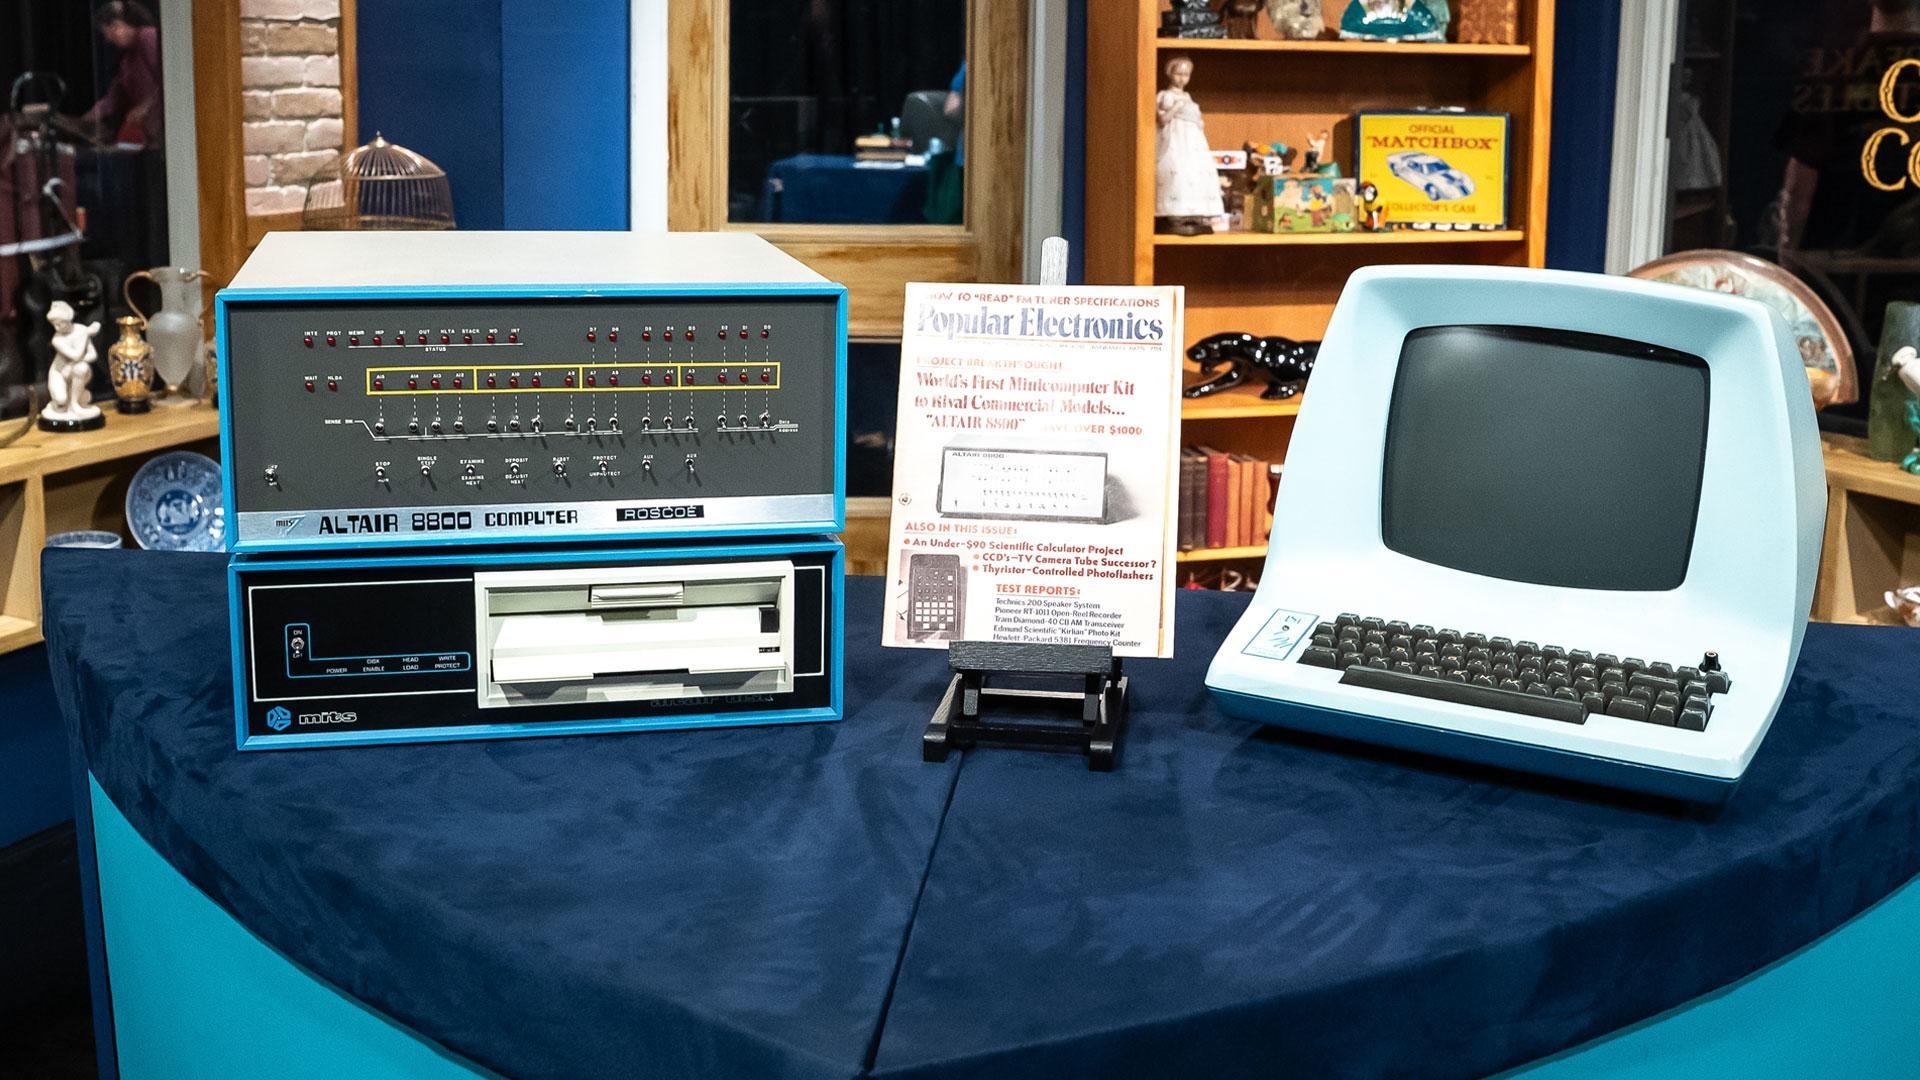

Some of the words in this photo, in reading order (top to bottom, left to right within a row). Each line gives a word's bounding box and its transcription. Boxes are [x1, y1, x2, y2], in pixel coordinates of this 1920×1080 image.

[1408, 124, 1455, 134] OFFICIAL
[1451, 203, 1476, 213] CASE
[974, 293, 1014, 303] "READ"
[1073, 297, 1161, 308] SPECIFICATIONS
[917, 303, 1014, 340] Popular
[1019, 306, 1163, 341] Electronics
[916, 356, 963, 367] POJECT
[916, 372, 969, 389] World's
[972, 374, 1005, 391] First
[1009, 377, 1110, 397] Minicomputer
[1113, 380, 1135, 396] Kit
[915, 396, 928, 408] to
[971, 395, 1055, 413] Commercial
[926, 414, 982, 429] "ALTAIR
[1109, 424, 1143, 436] $1000
[623, 507, 698, 520] ROSCOE
[318, 513, 399, 535] ALTAIR
[411, 511, 472, 532] 8800
[484, 509, 578, 527] COMPUTER
[905, 522, 936, 532] ALSO
[939, 523, 951, 533] IN
[954, 524, 978, 534] THIS
[912, 538, 927, 547] An
[930, 538, 987, 550] Under-$90
[988, 541, 1034, 552] Scientific
[1036, 543, 1086, 554] Calculator
[1088, 545, 1124, 557] Project
[1035, 554, 1072, 565] Camera
[1074, 556, 1099, 567] Tube
[982, 564, 1085, 578] Thyristor-Controlled
[1087, 568, 1154, 581] Photoflashers
[996, 583, 1022, 593] TEST
[1024, 585, 1081, 596] REPORTS:
[995, 597, 1026, 606] Technics
[1027, 599, 1043, 607] 200
[1043, 600, 1072, 608] Speaker
[1073, 601, 1101, 609] System
[994, 606, 1022, 614] Pioneer
[1089, 611, 1122, 619] Recorder
[993, 624, 1023, 633] Edmund
[1024, 625, 1057, 634] Scientific
[1088, 629, 1110, 637] Photo
[1084, 619, 1125, 629] Transceiver
[1073, 636, 1112, 646] Frequency
[1112, 638, 1141, 648] Counter
[434, 662, 461, 670] PROTECT
[299, 711, 358, 725] mits
